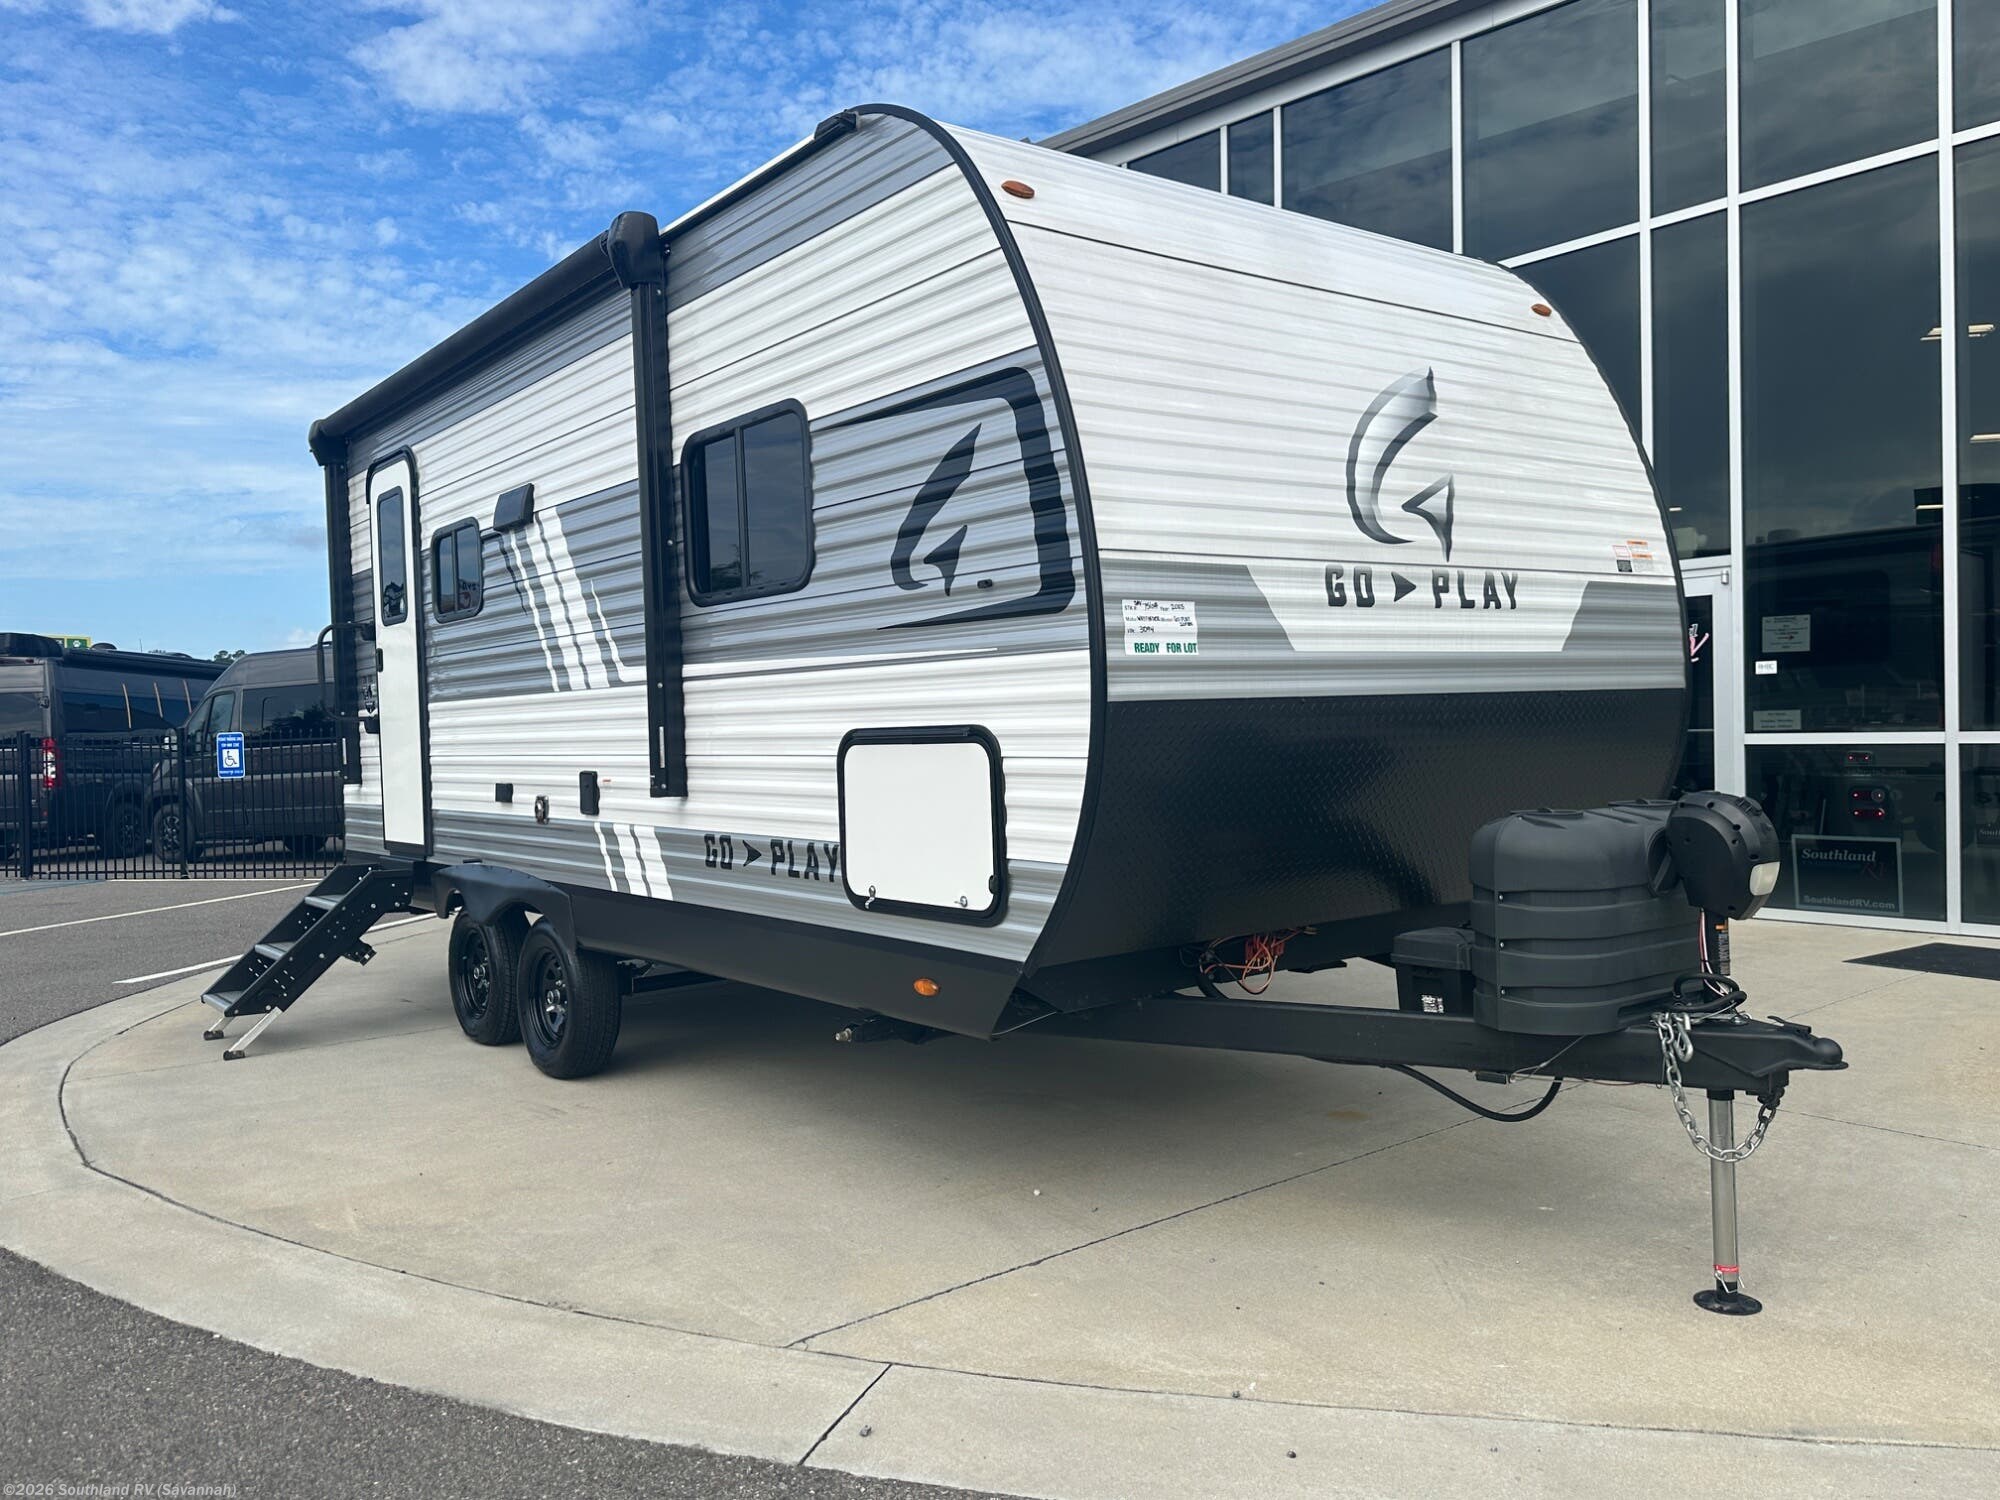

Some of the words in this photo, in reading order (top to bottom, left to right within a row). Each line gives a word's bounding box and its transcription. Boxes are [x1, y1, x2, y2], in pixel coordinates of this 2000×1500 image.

[1324, 564, 1376, 608] GO
[1432, 568, 1519, 610] PLAY
[1134, 642, 1160, 653] READY
[1166, 642, 1182, 653] FOR
[1184, 642, 1197, 653] LOT
[704, 834, 734, 870] GO
[770, 838, 840, 883] PLAY
[1801, 848, 1877, 862] Southland
[1803, 895, 1896, 909] SouthlandRV.com
